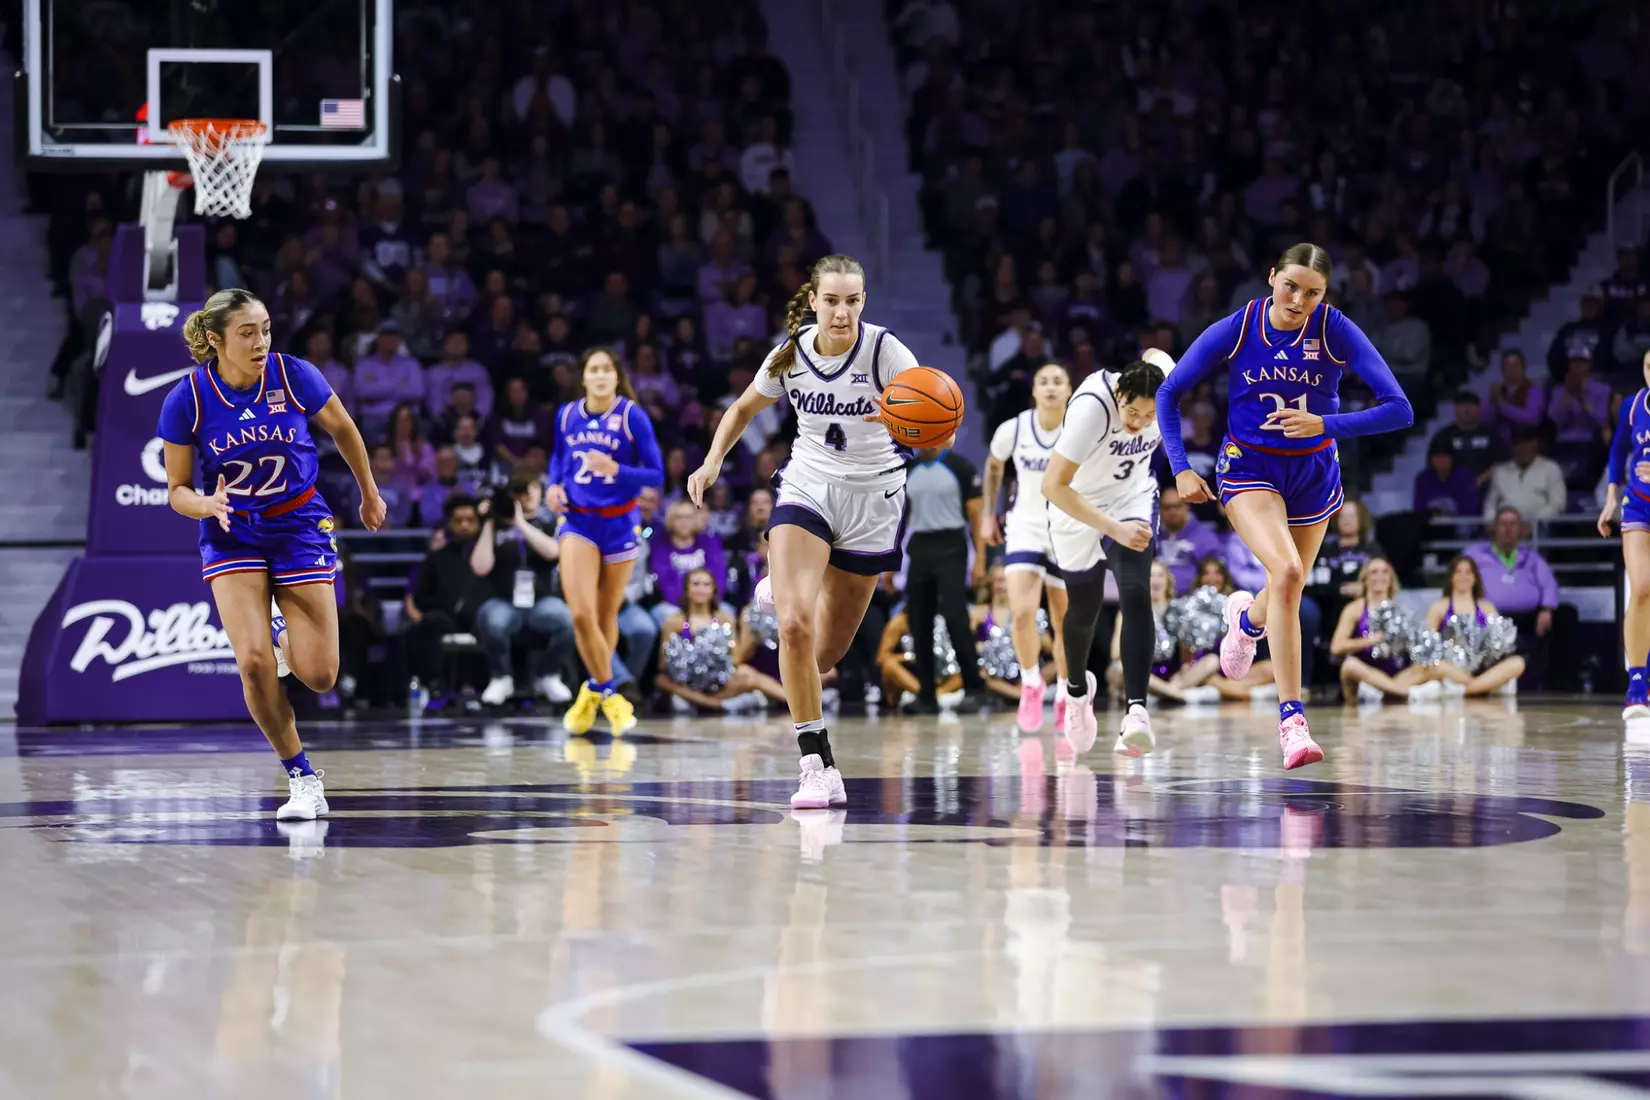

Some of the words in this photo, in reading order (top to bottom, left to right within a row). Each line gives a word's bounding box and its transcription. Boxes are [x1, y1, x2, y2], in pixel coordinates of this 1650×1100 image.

[1242, 366, 1322, 386] KANSAS
[790, 388, 876, 416] Wildcats
[208, 425, 297, 455] KANSAS
[566, 431, 621, 451] KANSAS
[824, 422, 848, 451] 4
[1109, 435, 1160, 456] Wildca
[223, 455, 287, 496] 22
[1113, 454, 1149, 480] 3
